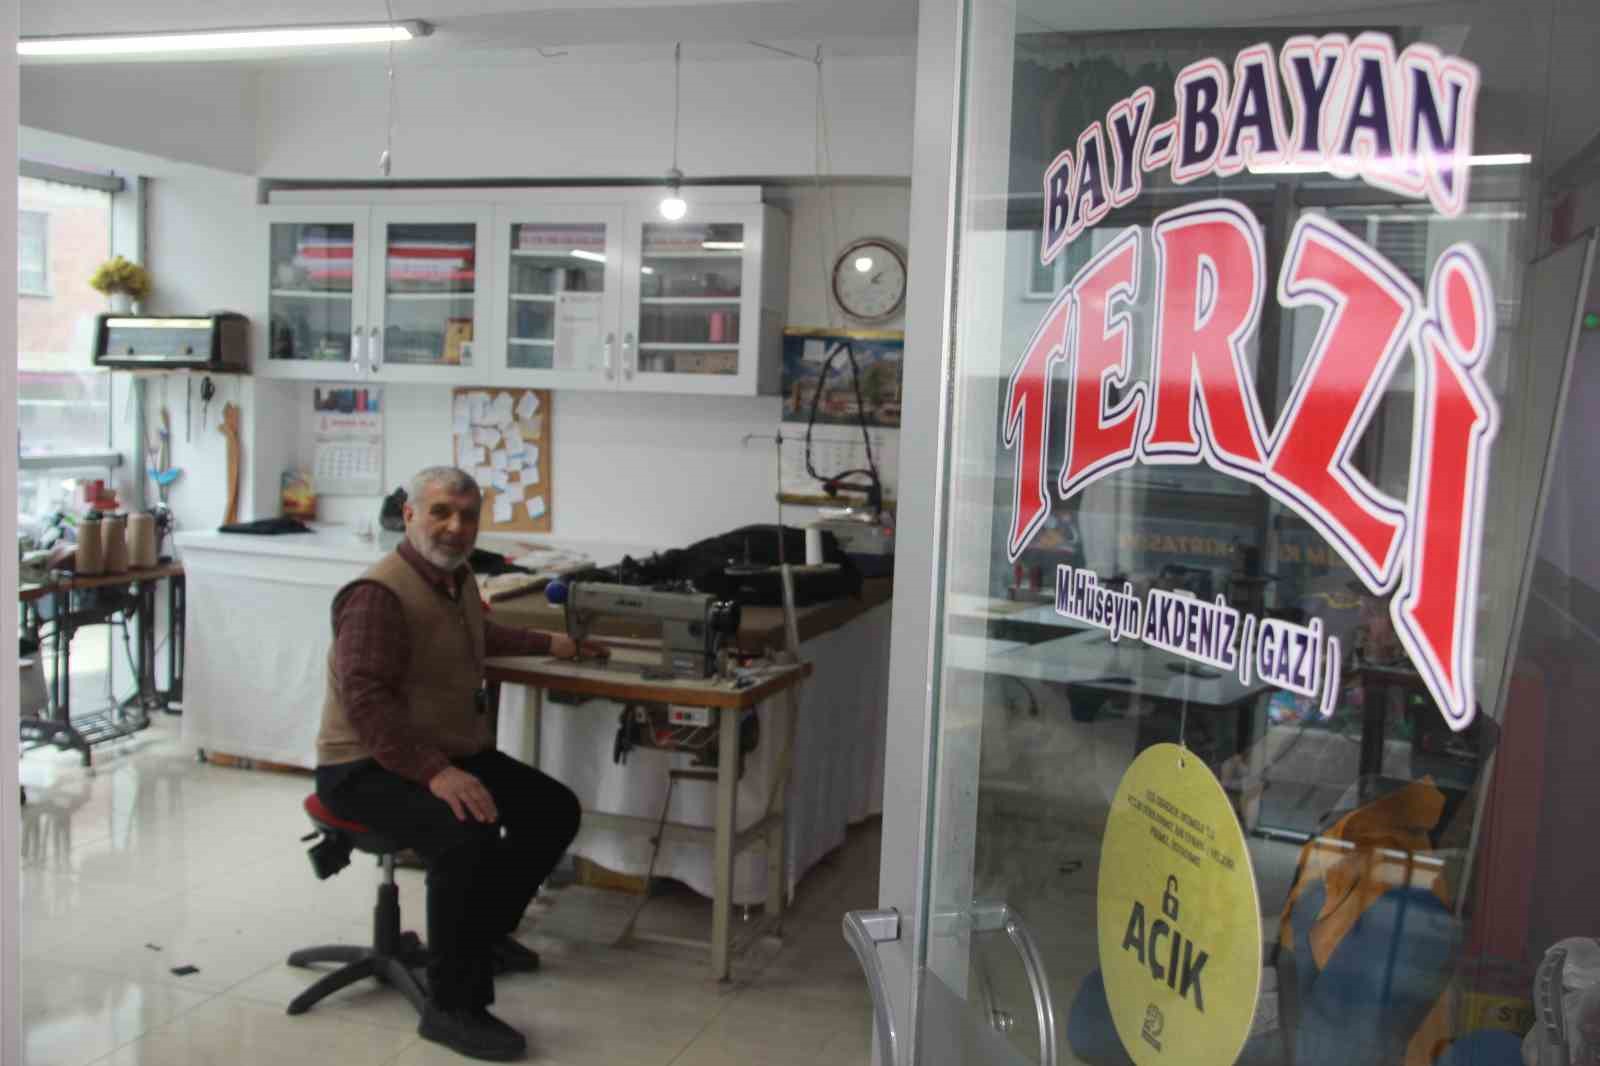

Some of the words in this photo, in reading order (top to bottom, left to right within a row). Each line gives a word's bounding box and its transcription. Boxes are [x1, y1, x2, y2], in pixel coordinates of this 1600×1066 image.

[1044, 36, 1476, 260] BAY-BAYAN
[1057, 566, 1140, 640] M.Hüseyin
[1144, 592, 1237, 668] AKDENİZ
[1122, 900, 1208, 1012] AÇIK
